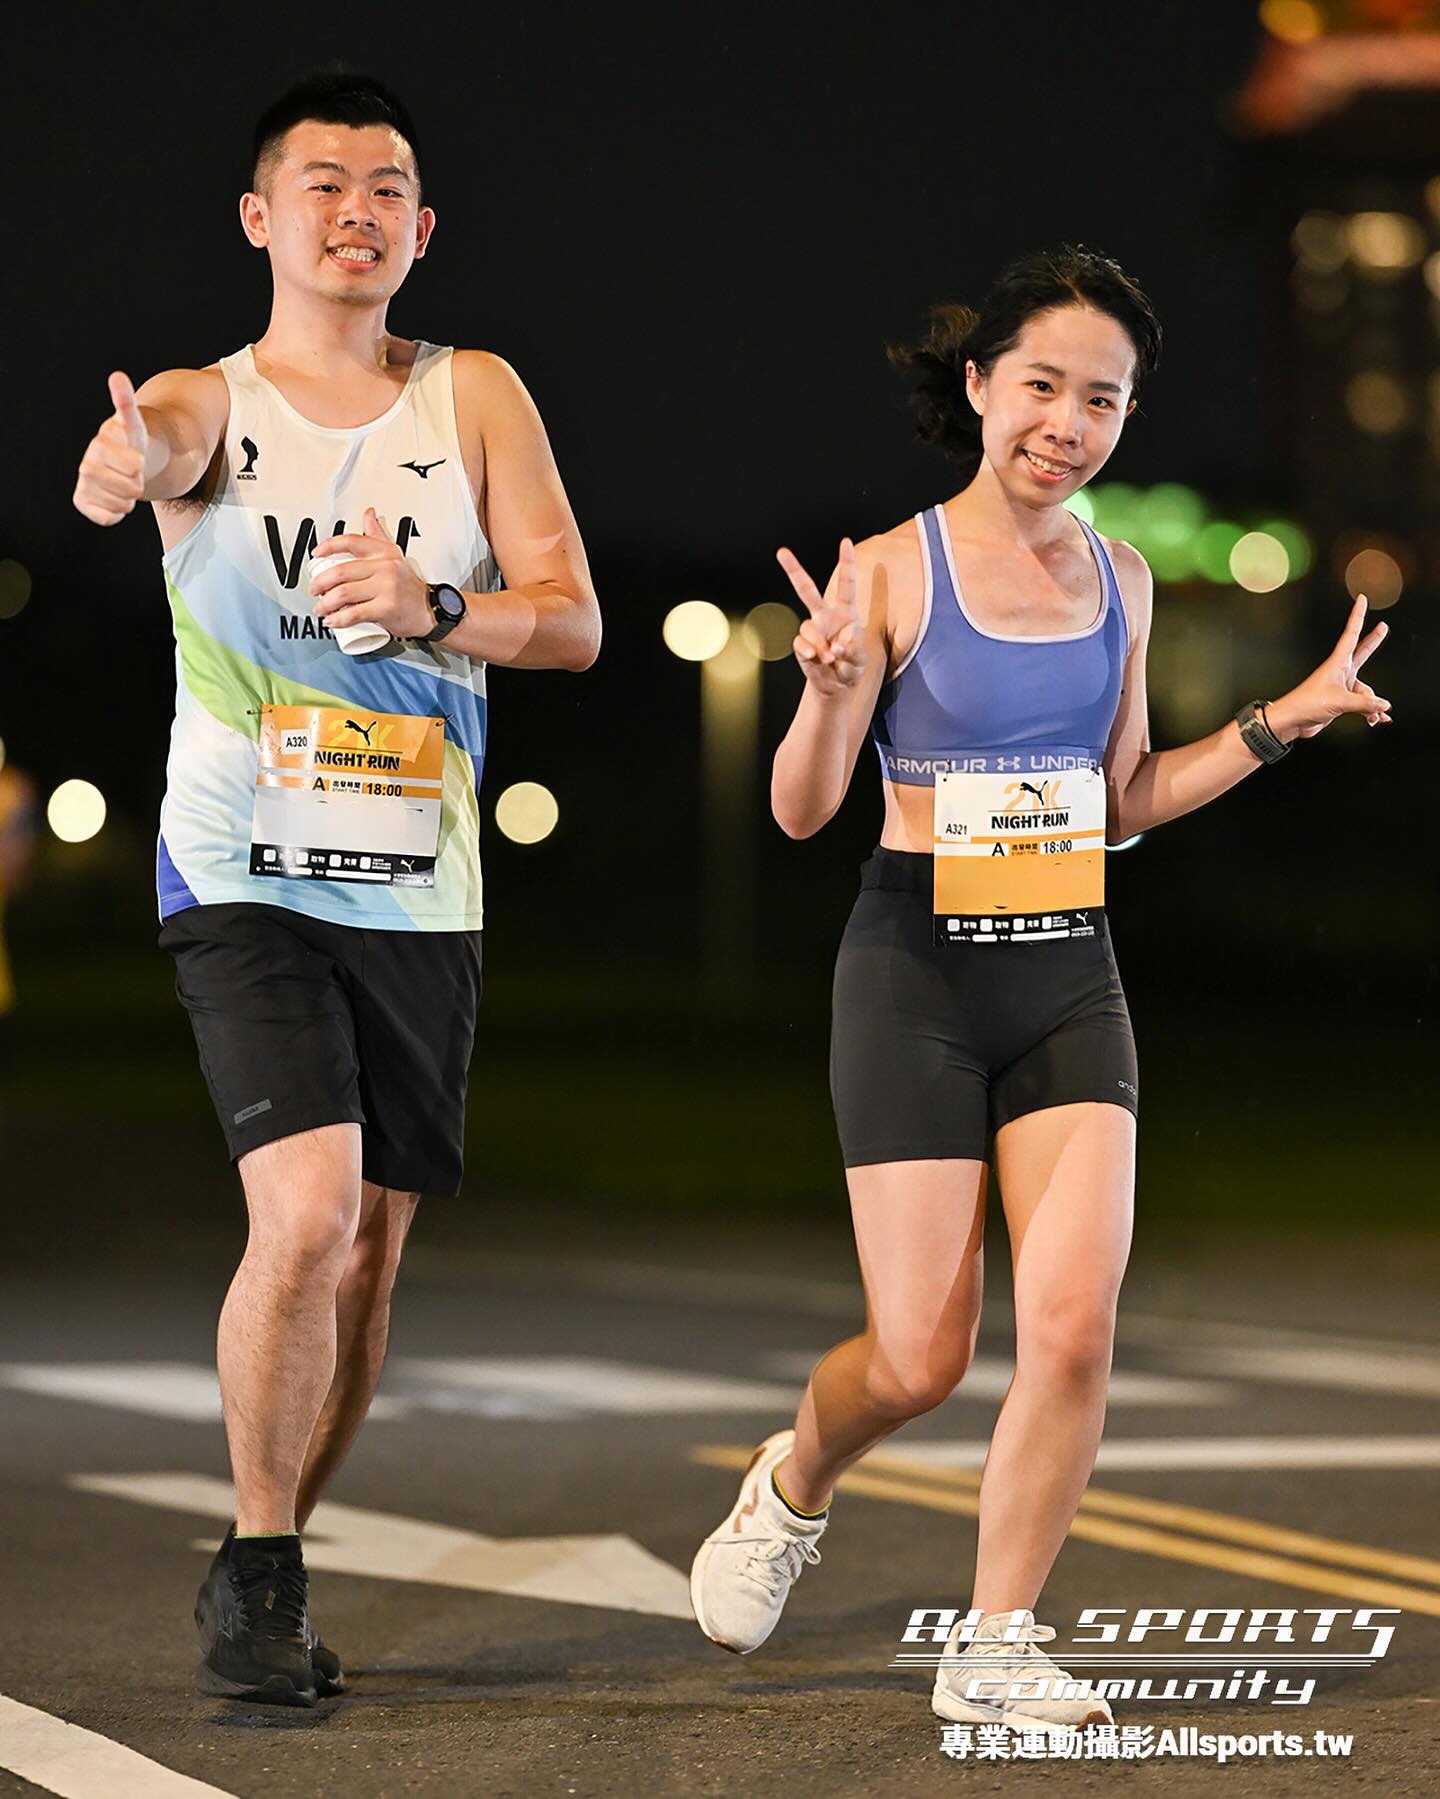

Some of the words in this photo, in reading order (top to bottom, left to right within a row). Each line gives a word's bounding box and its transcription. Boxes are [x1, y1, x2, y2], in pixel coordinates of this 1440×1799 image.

[286, 736, 308, 747] A320
[314, 751, 366, 767] NIGHT
[367, 755, 400, 770] RUN
[886, 756, 987, 774] ARMOUR
[312, 776, 326, 791] A
[367, 782, 402, 797] 18:00
[991, 814, 1041, 829] NIGHT
[1042, 812, 1069, 827] RUN
[945, 823, 968, 836] A321
[991, 842, 1006, 857] A
[1043, 839, 1073, 854] 18:00
